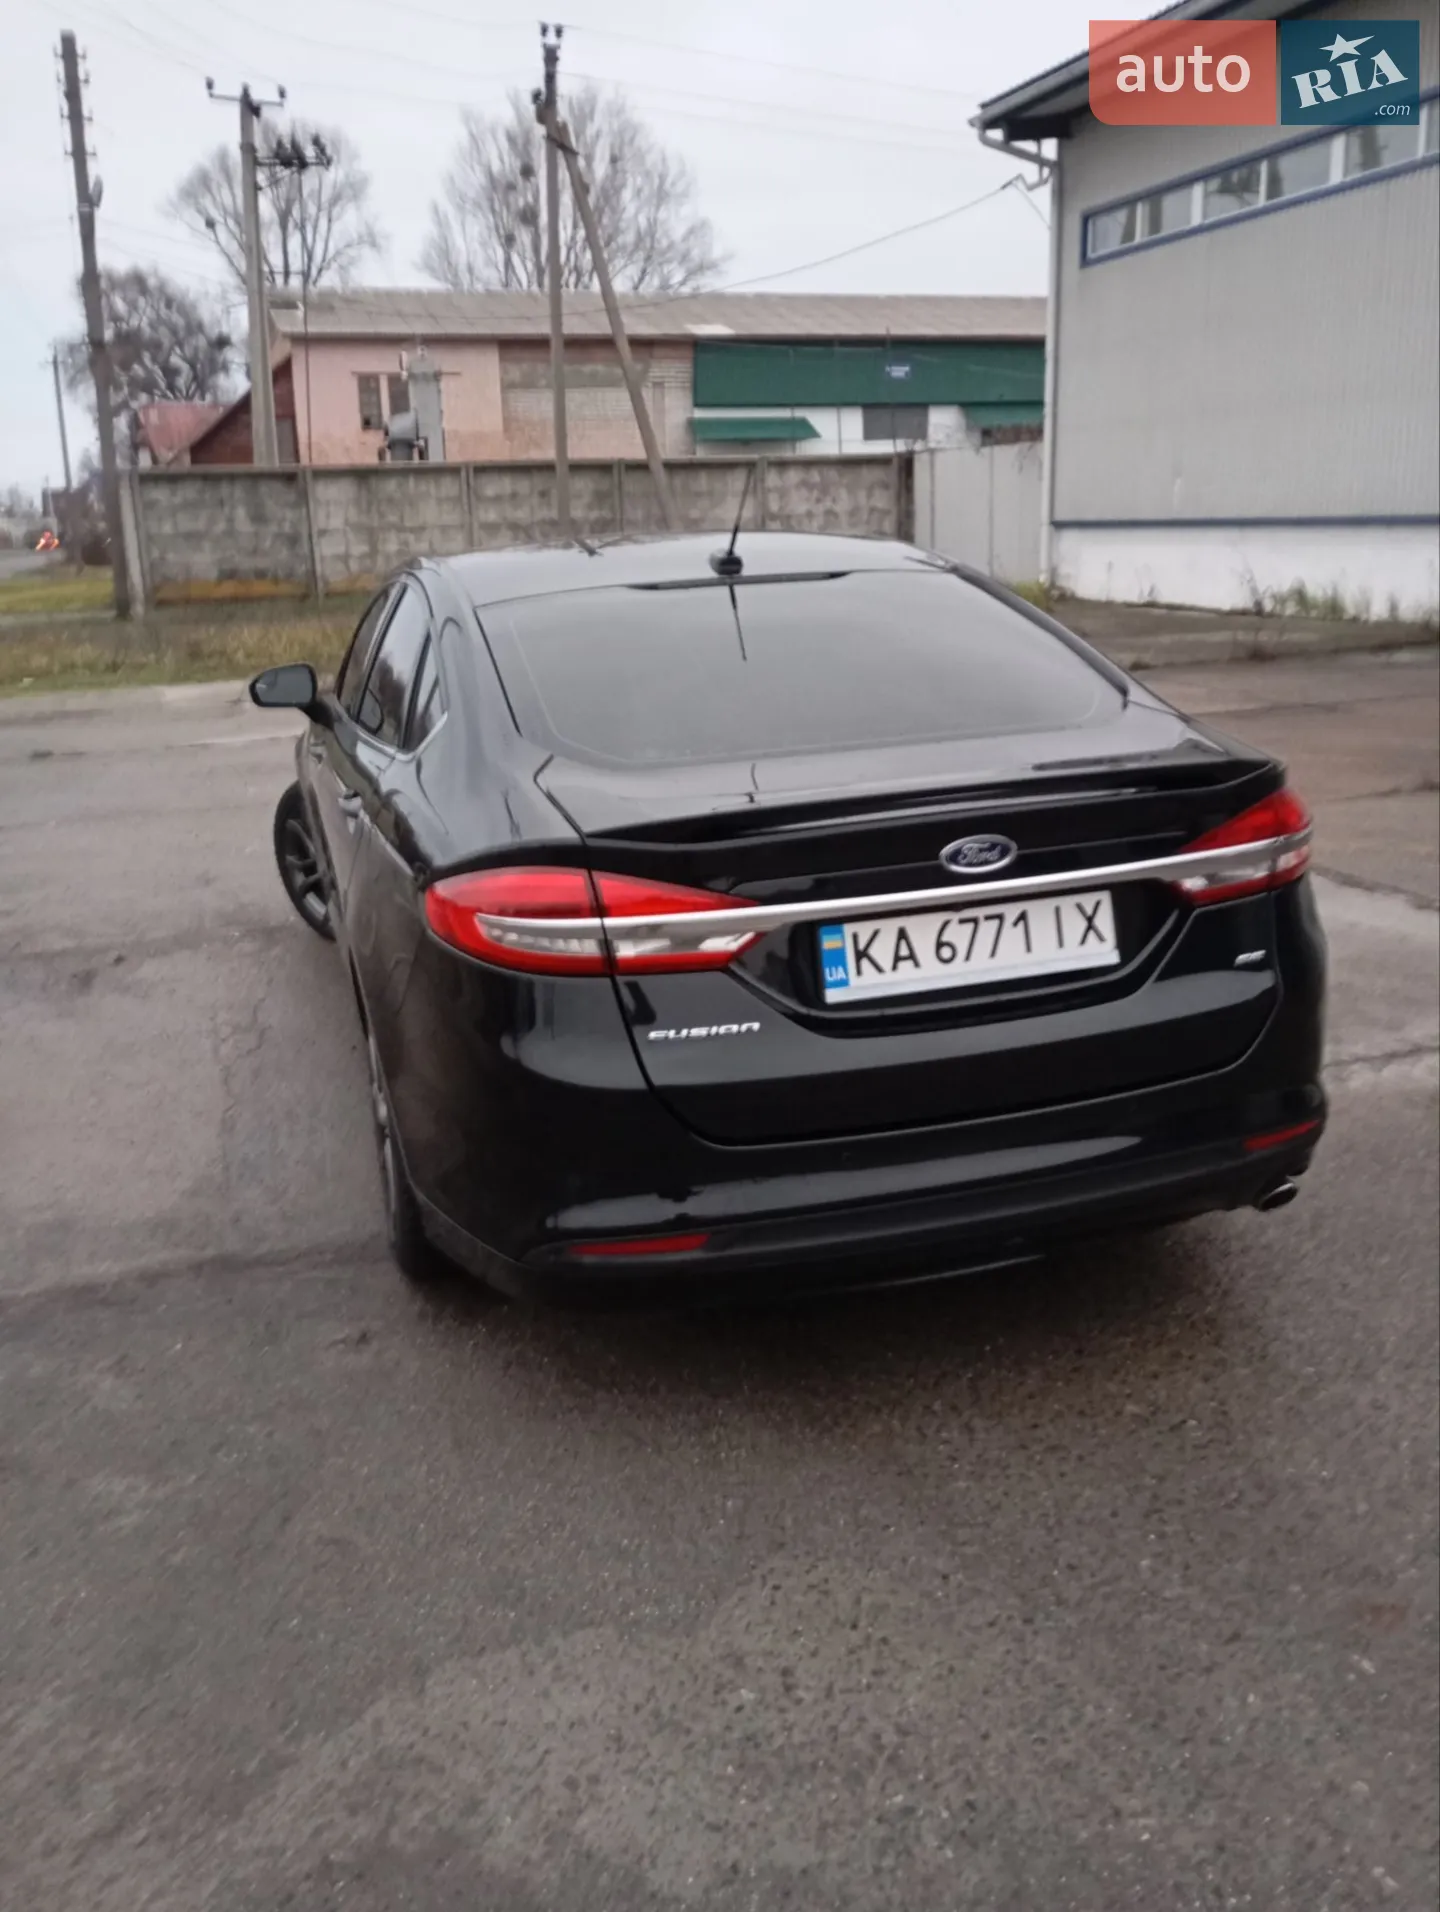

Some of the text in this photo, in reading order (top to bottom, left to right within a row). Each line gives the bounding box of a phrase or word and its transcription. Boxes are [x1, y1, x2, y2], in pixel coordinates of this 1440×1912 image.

[958, 842, 1002, 865] Ford
[852, 899, 1107, 977] KA 6771 IX
[825, 966, 847, 981] UA
[647, 1021, 761, 1041] FUSION
